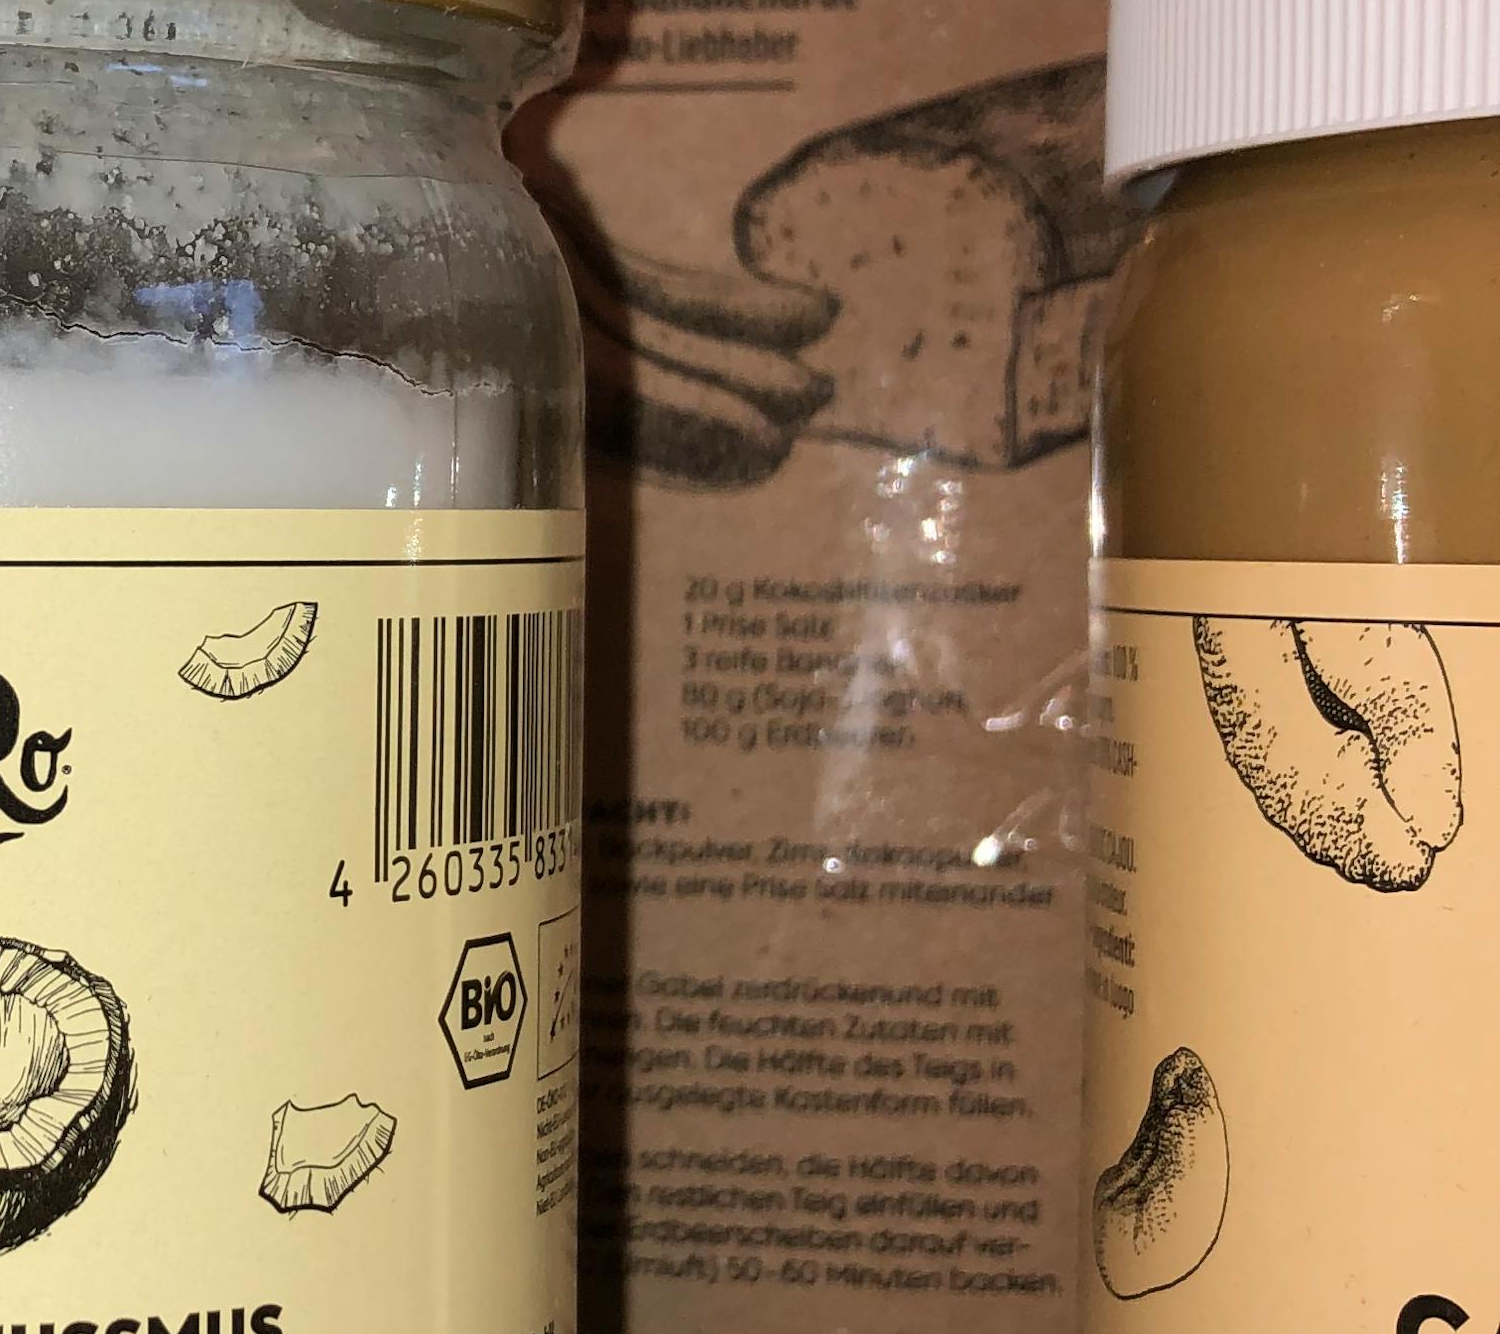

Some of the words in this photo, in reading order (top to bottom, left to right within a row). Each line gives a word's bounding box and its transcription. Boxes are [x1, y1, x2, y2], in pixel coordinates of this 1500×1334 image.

[684, 577, 718, 603] 20
[725, 581, 745, 606] g
[702, 613, 767, 637] Prise
[775, 614, 833, 640] Salz
[705, 648, 768, 672] reife
[725, 688, 746, 714] g
[737, 723, 758, 751] g
[329, 859, 353, 907] 4
[391, 840, 520, 903] 260335
[742, 875, 808, 901] Prise
[816, 877, 869, 903] Salz
[879, 879, 1055, 906] miteinander
[637, 973, 723, 999] Gabel
[950, 984, 999, 1009] mit
[655, 1008, 700, 1033] Die
[708, 1009, 836, 1038] feuchten
[844, 1013, 958, 1042] Zutaten
[965, 1020, 1014, 1045] mit
[704, 1045, 749, 1072] Die
[757, 1047, 845, 1075] Hälfte
[853, 1051, 903, 1078] des
[912, 1052, 982, 1084] Teigs
[989, 1057, 1016, 1081] in
[773, 1086, 940, 1117] Kastenform
[948, 1089, 1033, 1119] füllen.
[796, 1151, 841, 1178] die
[849, 1153, 936, 1182] Hälfte
[944, 1158, 1039, 1187] davon
[648, 1184, 786, 1210] restlichen
[793, 1186, 847, 1221] Teig
[855, 1189, 975, 1217] einfüllen
[984, 1194, 1040, 1223] und
[869, 1229, 968, 1257] darauf
[826, 1262, 943, 1291] Minuten
[949, 1265, 1063, 1296] backen.
